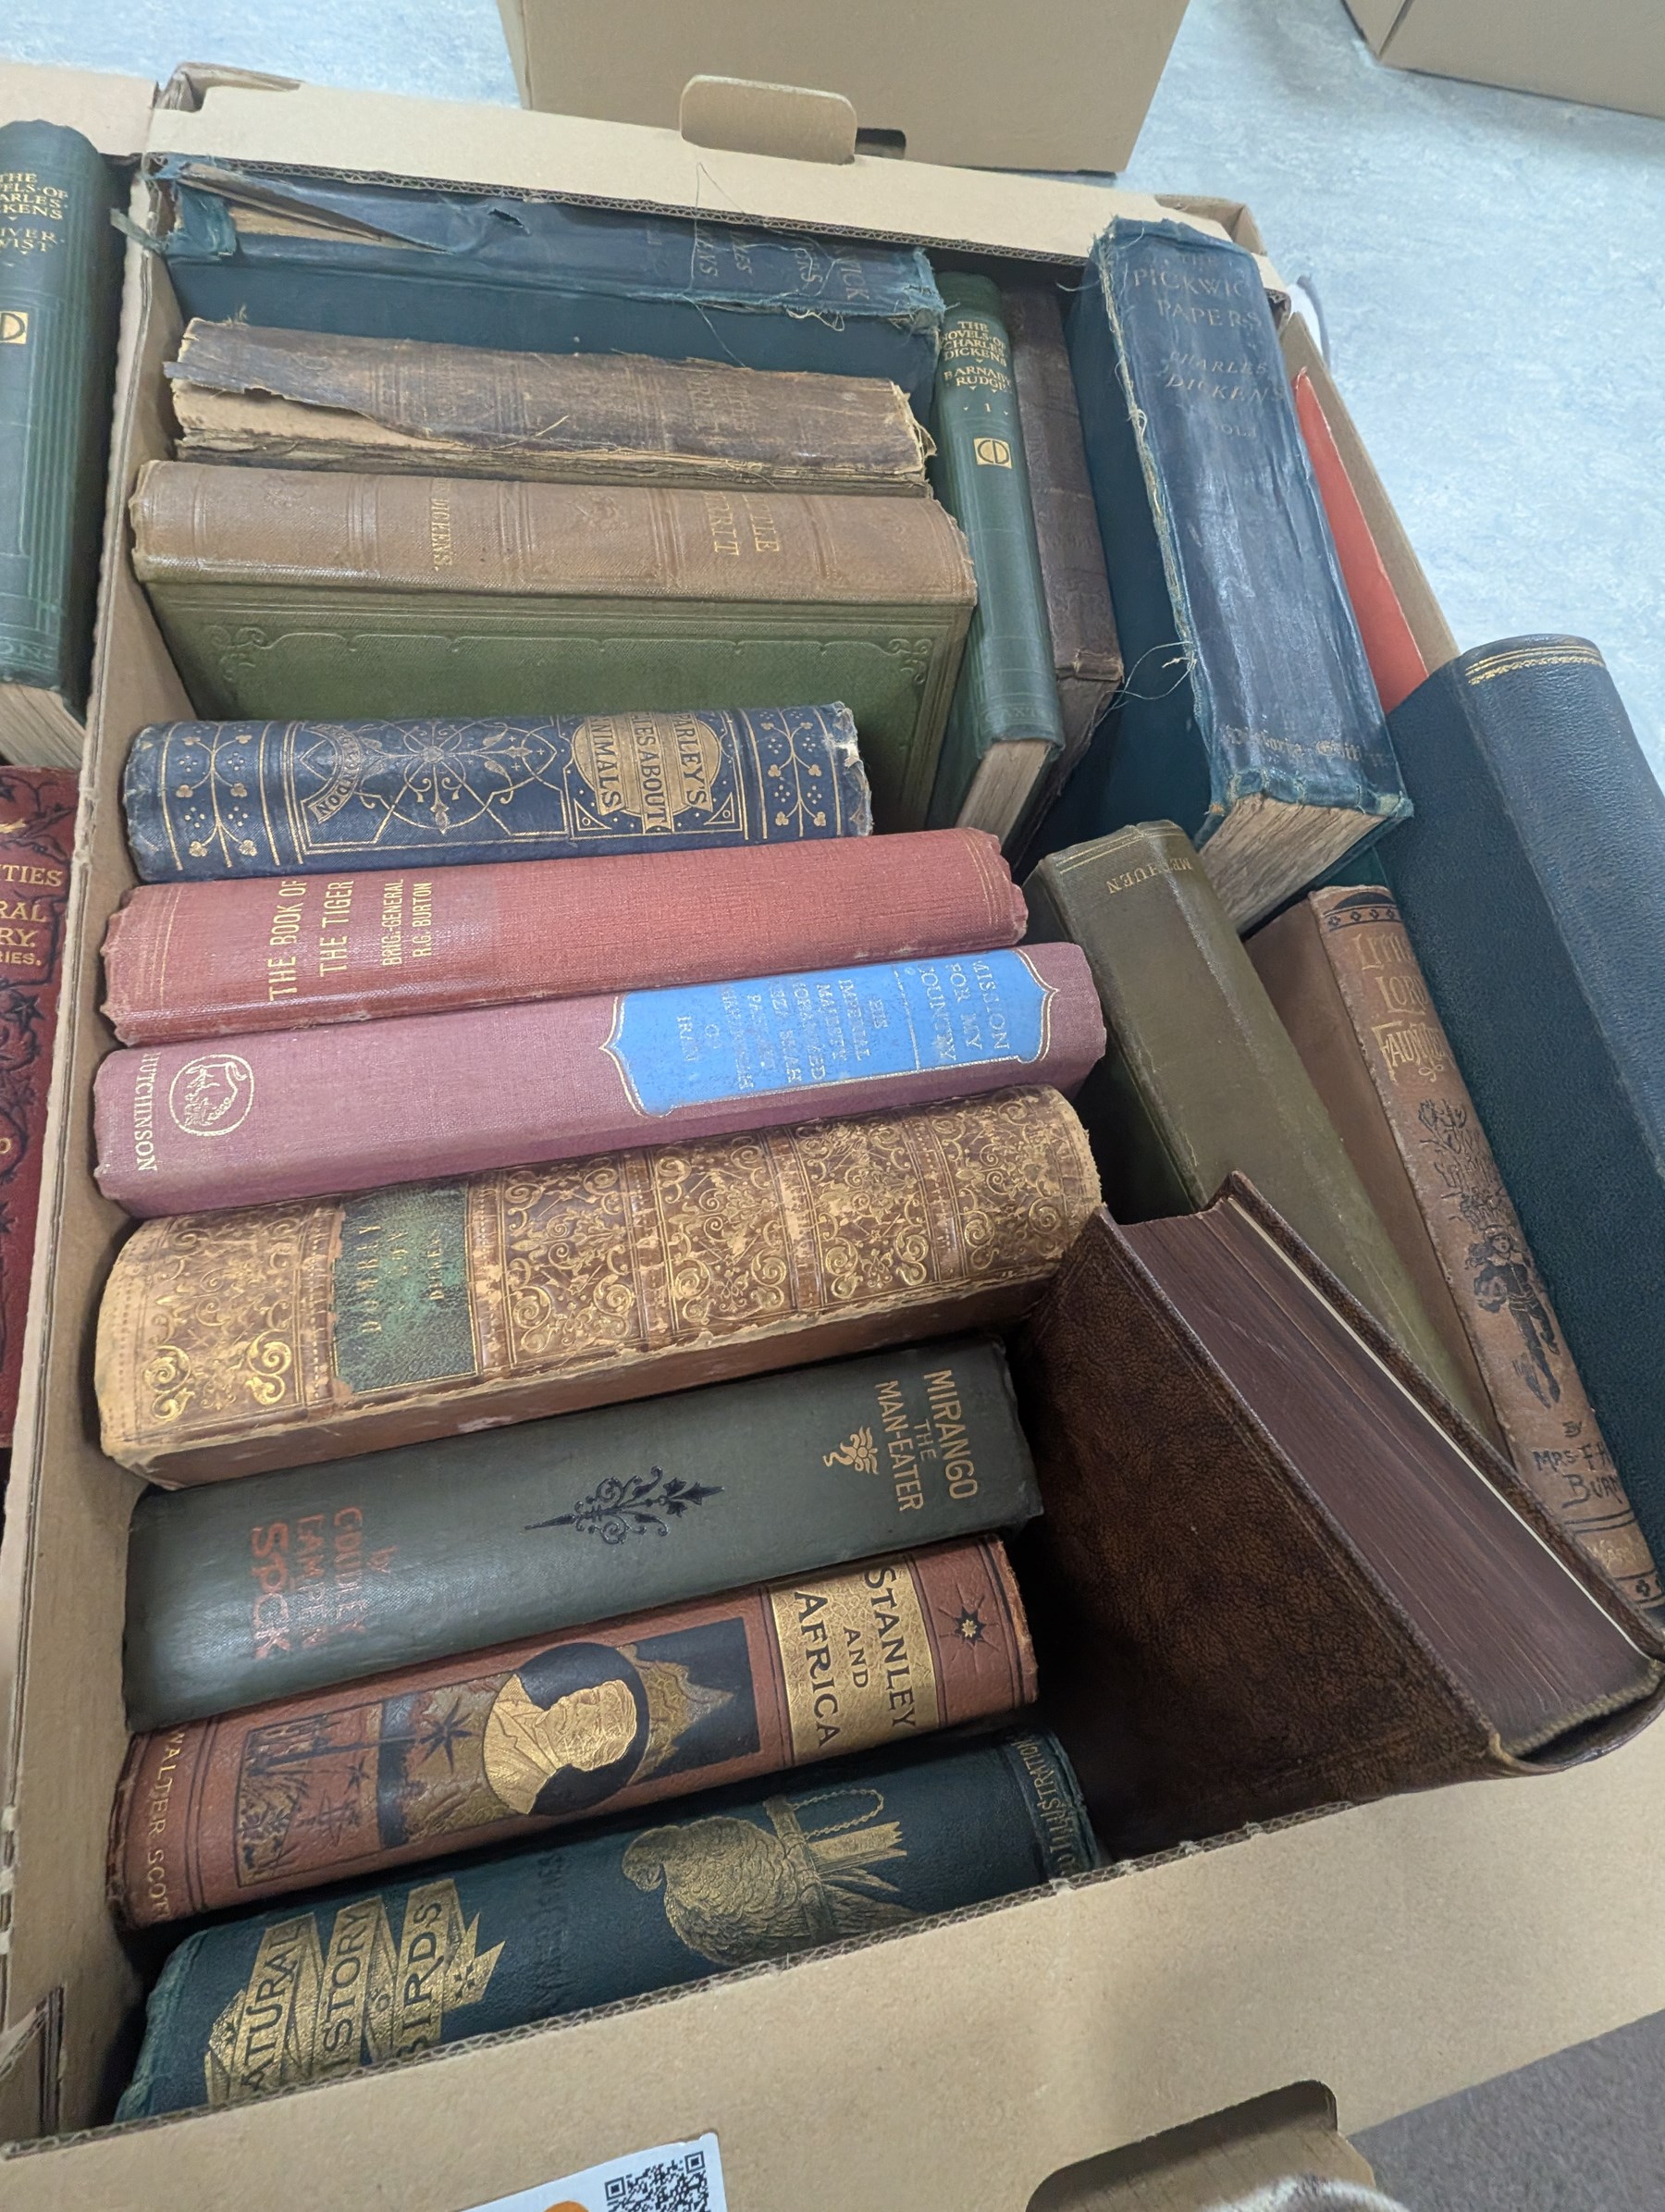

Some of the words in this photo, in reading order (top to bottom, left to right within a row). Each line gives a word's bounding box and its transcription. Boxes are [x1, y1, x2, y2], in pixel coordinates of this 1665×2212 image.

[1133, 267, 1246, 298] PICKWIC
[957, 321, 989, 333] THE
[944, 347, 1008, 367] DICKENS
[638, 749, 670, 824] ABOUT
[278, 879, 307, 897] OF
[1105, 858, 1193, 896] MEHUEN
[270, 902, 305, 946] BOOK
[321, 880, 354, 929] TIGER
[412, 882, 433, 929] BURTON
[267, 956, 298, 1002] THE
[319, 935, 348, 978] THE
[945, 962, 971, 1003] FOR
[1375, 976, 1428, 1016] LORD
[133, 1051, 162, 1171] HUTCHINSON
[875, 1380, 925, 1512] MAN-EATER
[913, 1418, 937, 1463] THE
[923, 1369, 979, 1500] MIRANGO
[843, 1626, 870, 1689] AND
[863, 1565, 917, 1728] STANLEY
[794, 1591, 842, 1749] AFRICA
[240, 1921, 302, 2092] ATURAL
[321, 1910, 371, 2075] ISTORY
